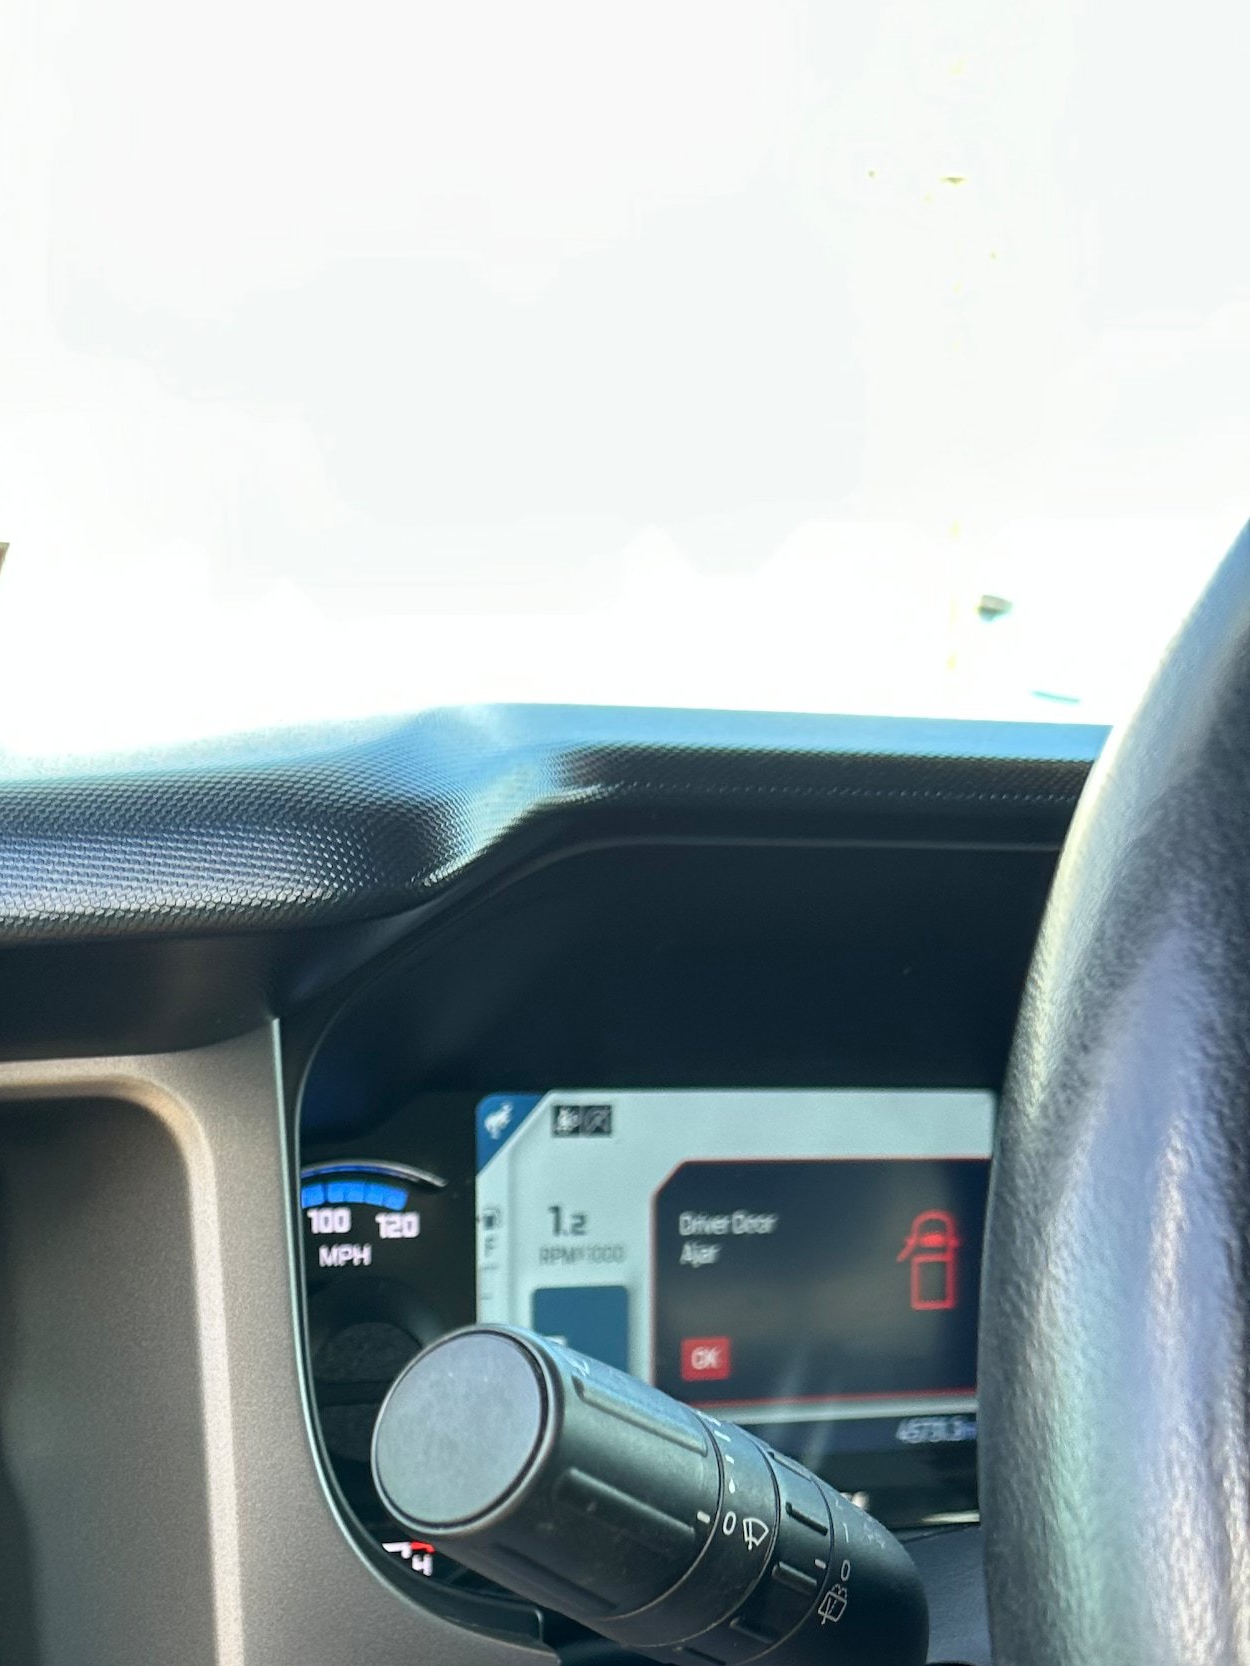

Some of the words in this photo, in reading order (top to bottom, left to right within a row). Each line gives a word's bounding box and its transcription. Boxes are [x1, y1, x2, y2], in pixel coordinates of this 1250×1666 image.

[306, 1207, 351, 1234] 100
[375, 1211, 421, 1239] 120
[547, 1204, 589, 1237] 1.2
[679, 1211, 730, 1236] Driver
[731, 1209, 778, 1235] Door
[318, 1243, 372, 1267] MPH
[679, 1241, 721, 1268] Ajar
[690, 1346, 720, 1370] OK
